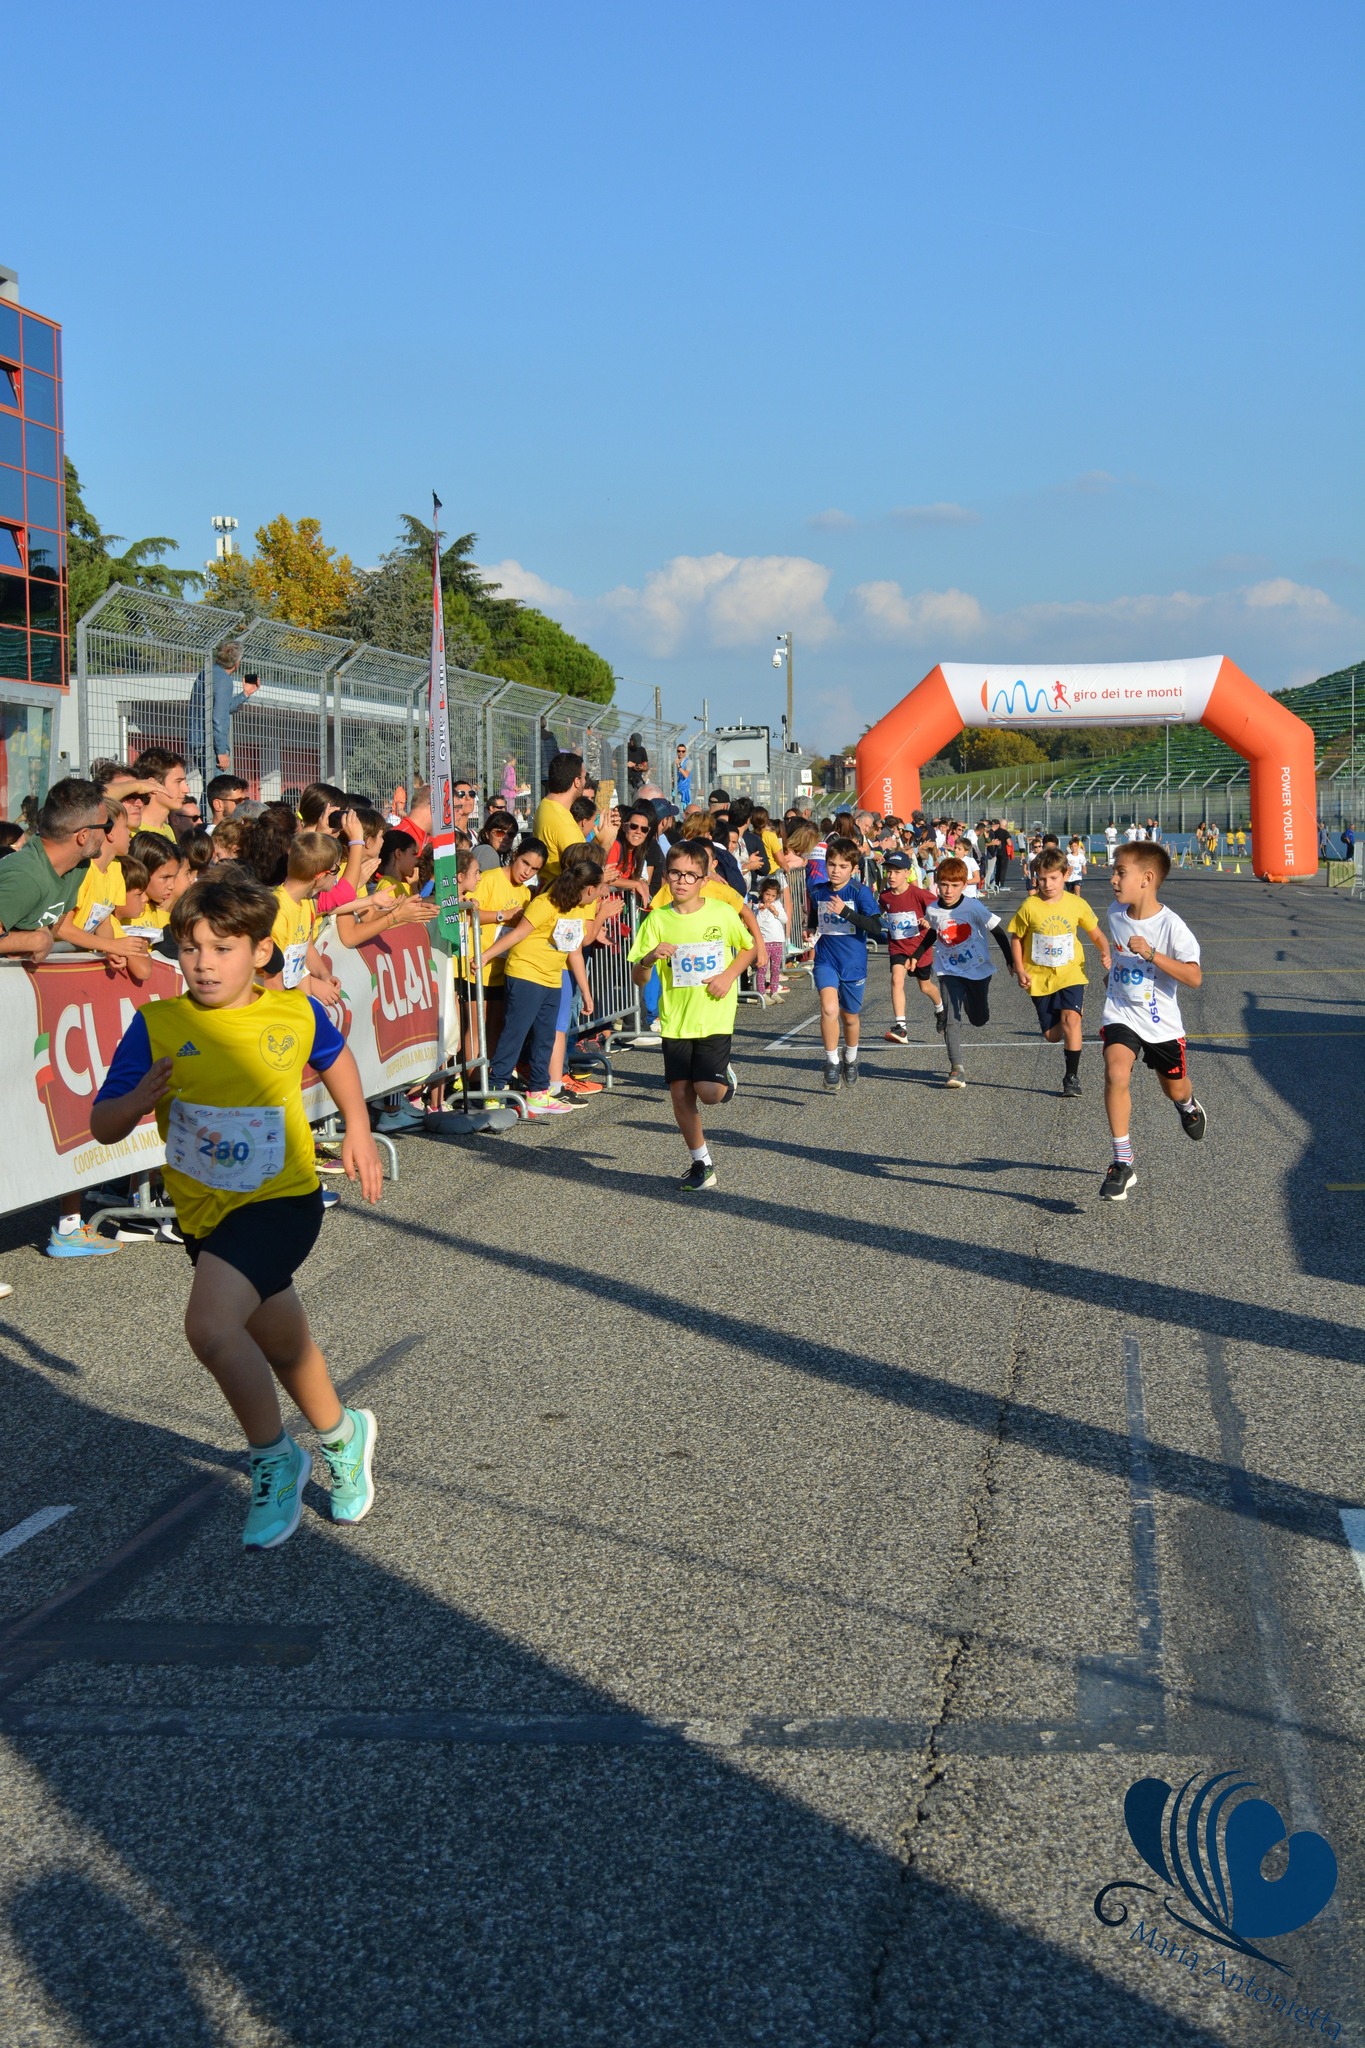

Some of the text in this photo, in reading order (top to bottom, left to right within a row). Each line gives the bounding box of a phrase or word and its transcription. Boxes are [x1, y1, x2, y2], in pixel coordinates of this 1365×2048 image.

[1073, 686, 1183, 702] giro dei tre monti
[882, 777, 894, 816] POWER
[1281, 766, 1295, 866] POWER YOUR LIFE
[891, 920, 912, 931] 642
[948, 949, 974, 966] 641
[1044, 947, 1063, 956] 255
[681, 955, 717, 973] 655
[376, 945, 433, 1022] CLAI
[1113, 966, 1144, 986] 669
[73, 1138, 131, 1175] COOPERATIVA
[131, 1134, 140, 1153] A
[199, 1137, 250, 1162] 280
